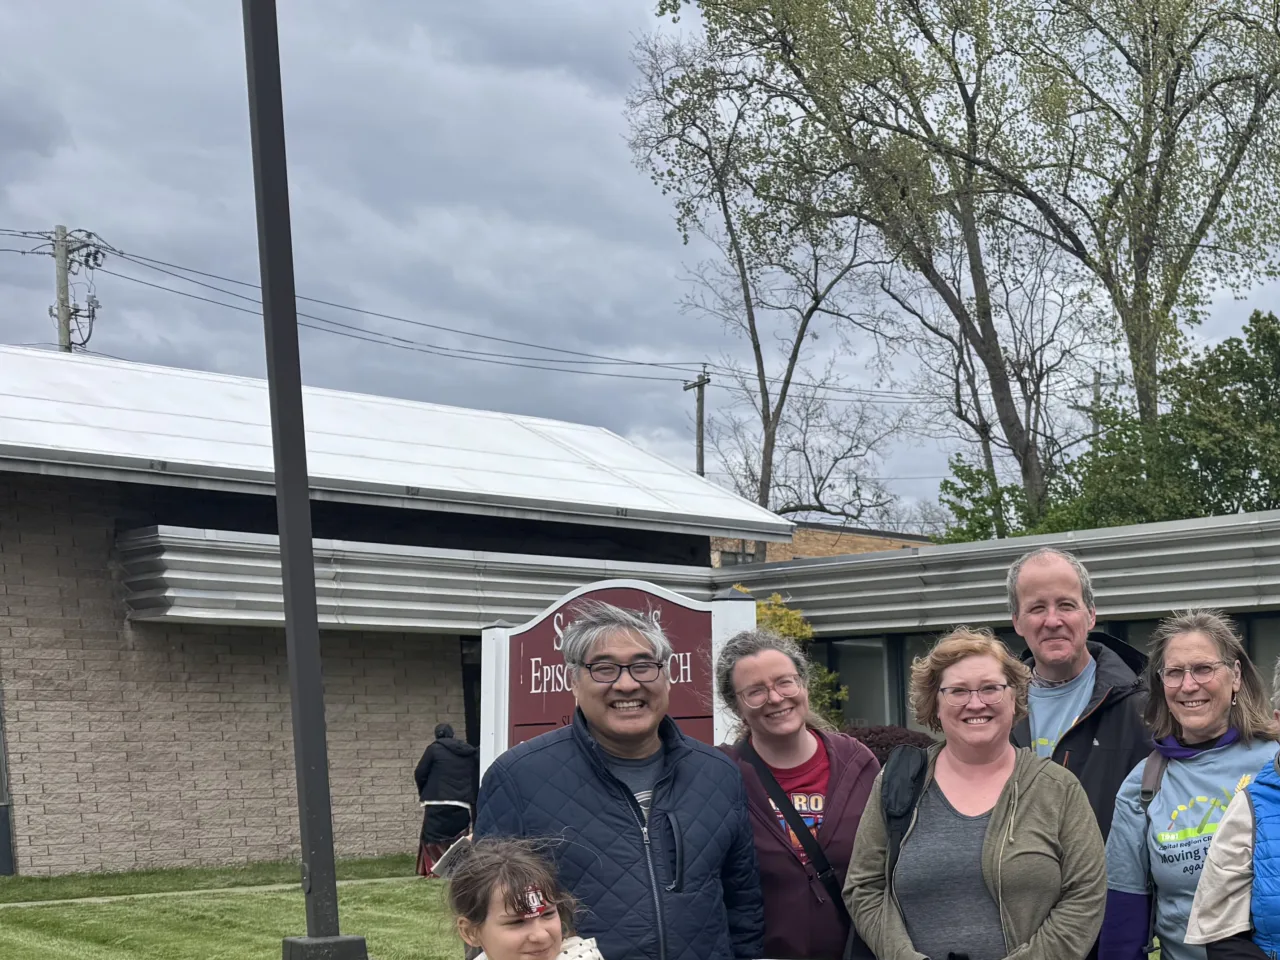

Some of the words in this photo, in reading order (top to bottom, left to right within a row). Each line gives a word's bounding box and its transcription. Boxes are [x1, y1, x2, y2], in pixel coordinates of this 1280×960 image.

[530, 657, 572, 694] EPISC
[791, 793, 824, 812] RO
[1162, 848, 1201, 863] Moving
[1183, 861, 1204, 875] agai
